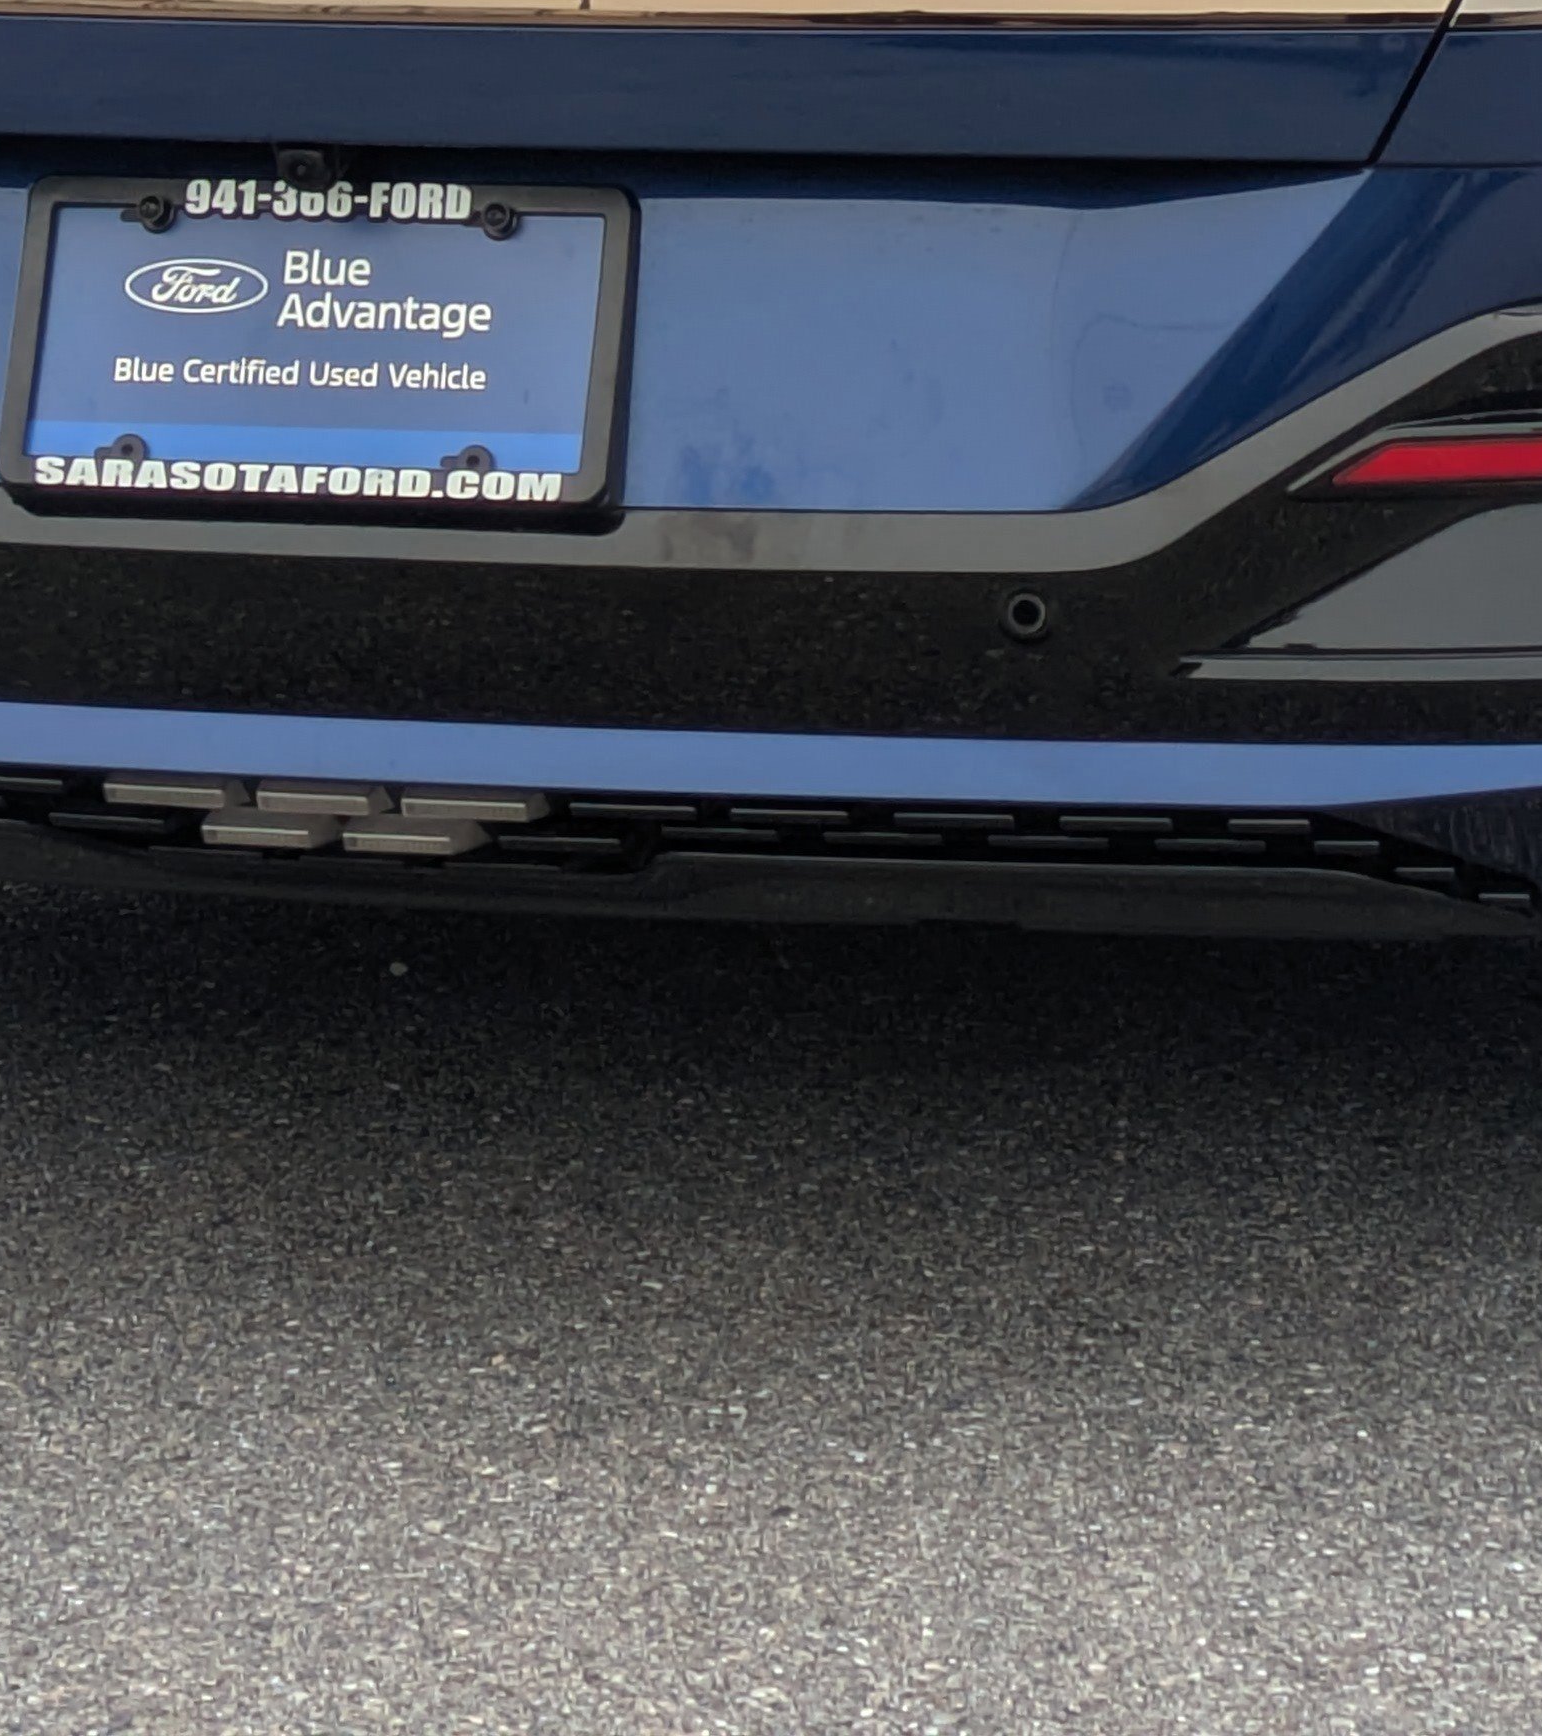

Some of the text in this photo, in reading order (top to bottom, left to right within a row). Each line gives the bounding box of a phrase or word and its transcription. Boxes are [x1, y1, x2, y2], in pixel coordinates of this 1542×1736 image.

[151, 267, 241, 306] Ford
[283, 249, 371, 286] Blue
[276, 292, 492, 338] Advantage
[113, 357, 487, 391] Blue Certified Used Vehicle
[34, 457, 562, 502] SARASOTAFORD.COM
